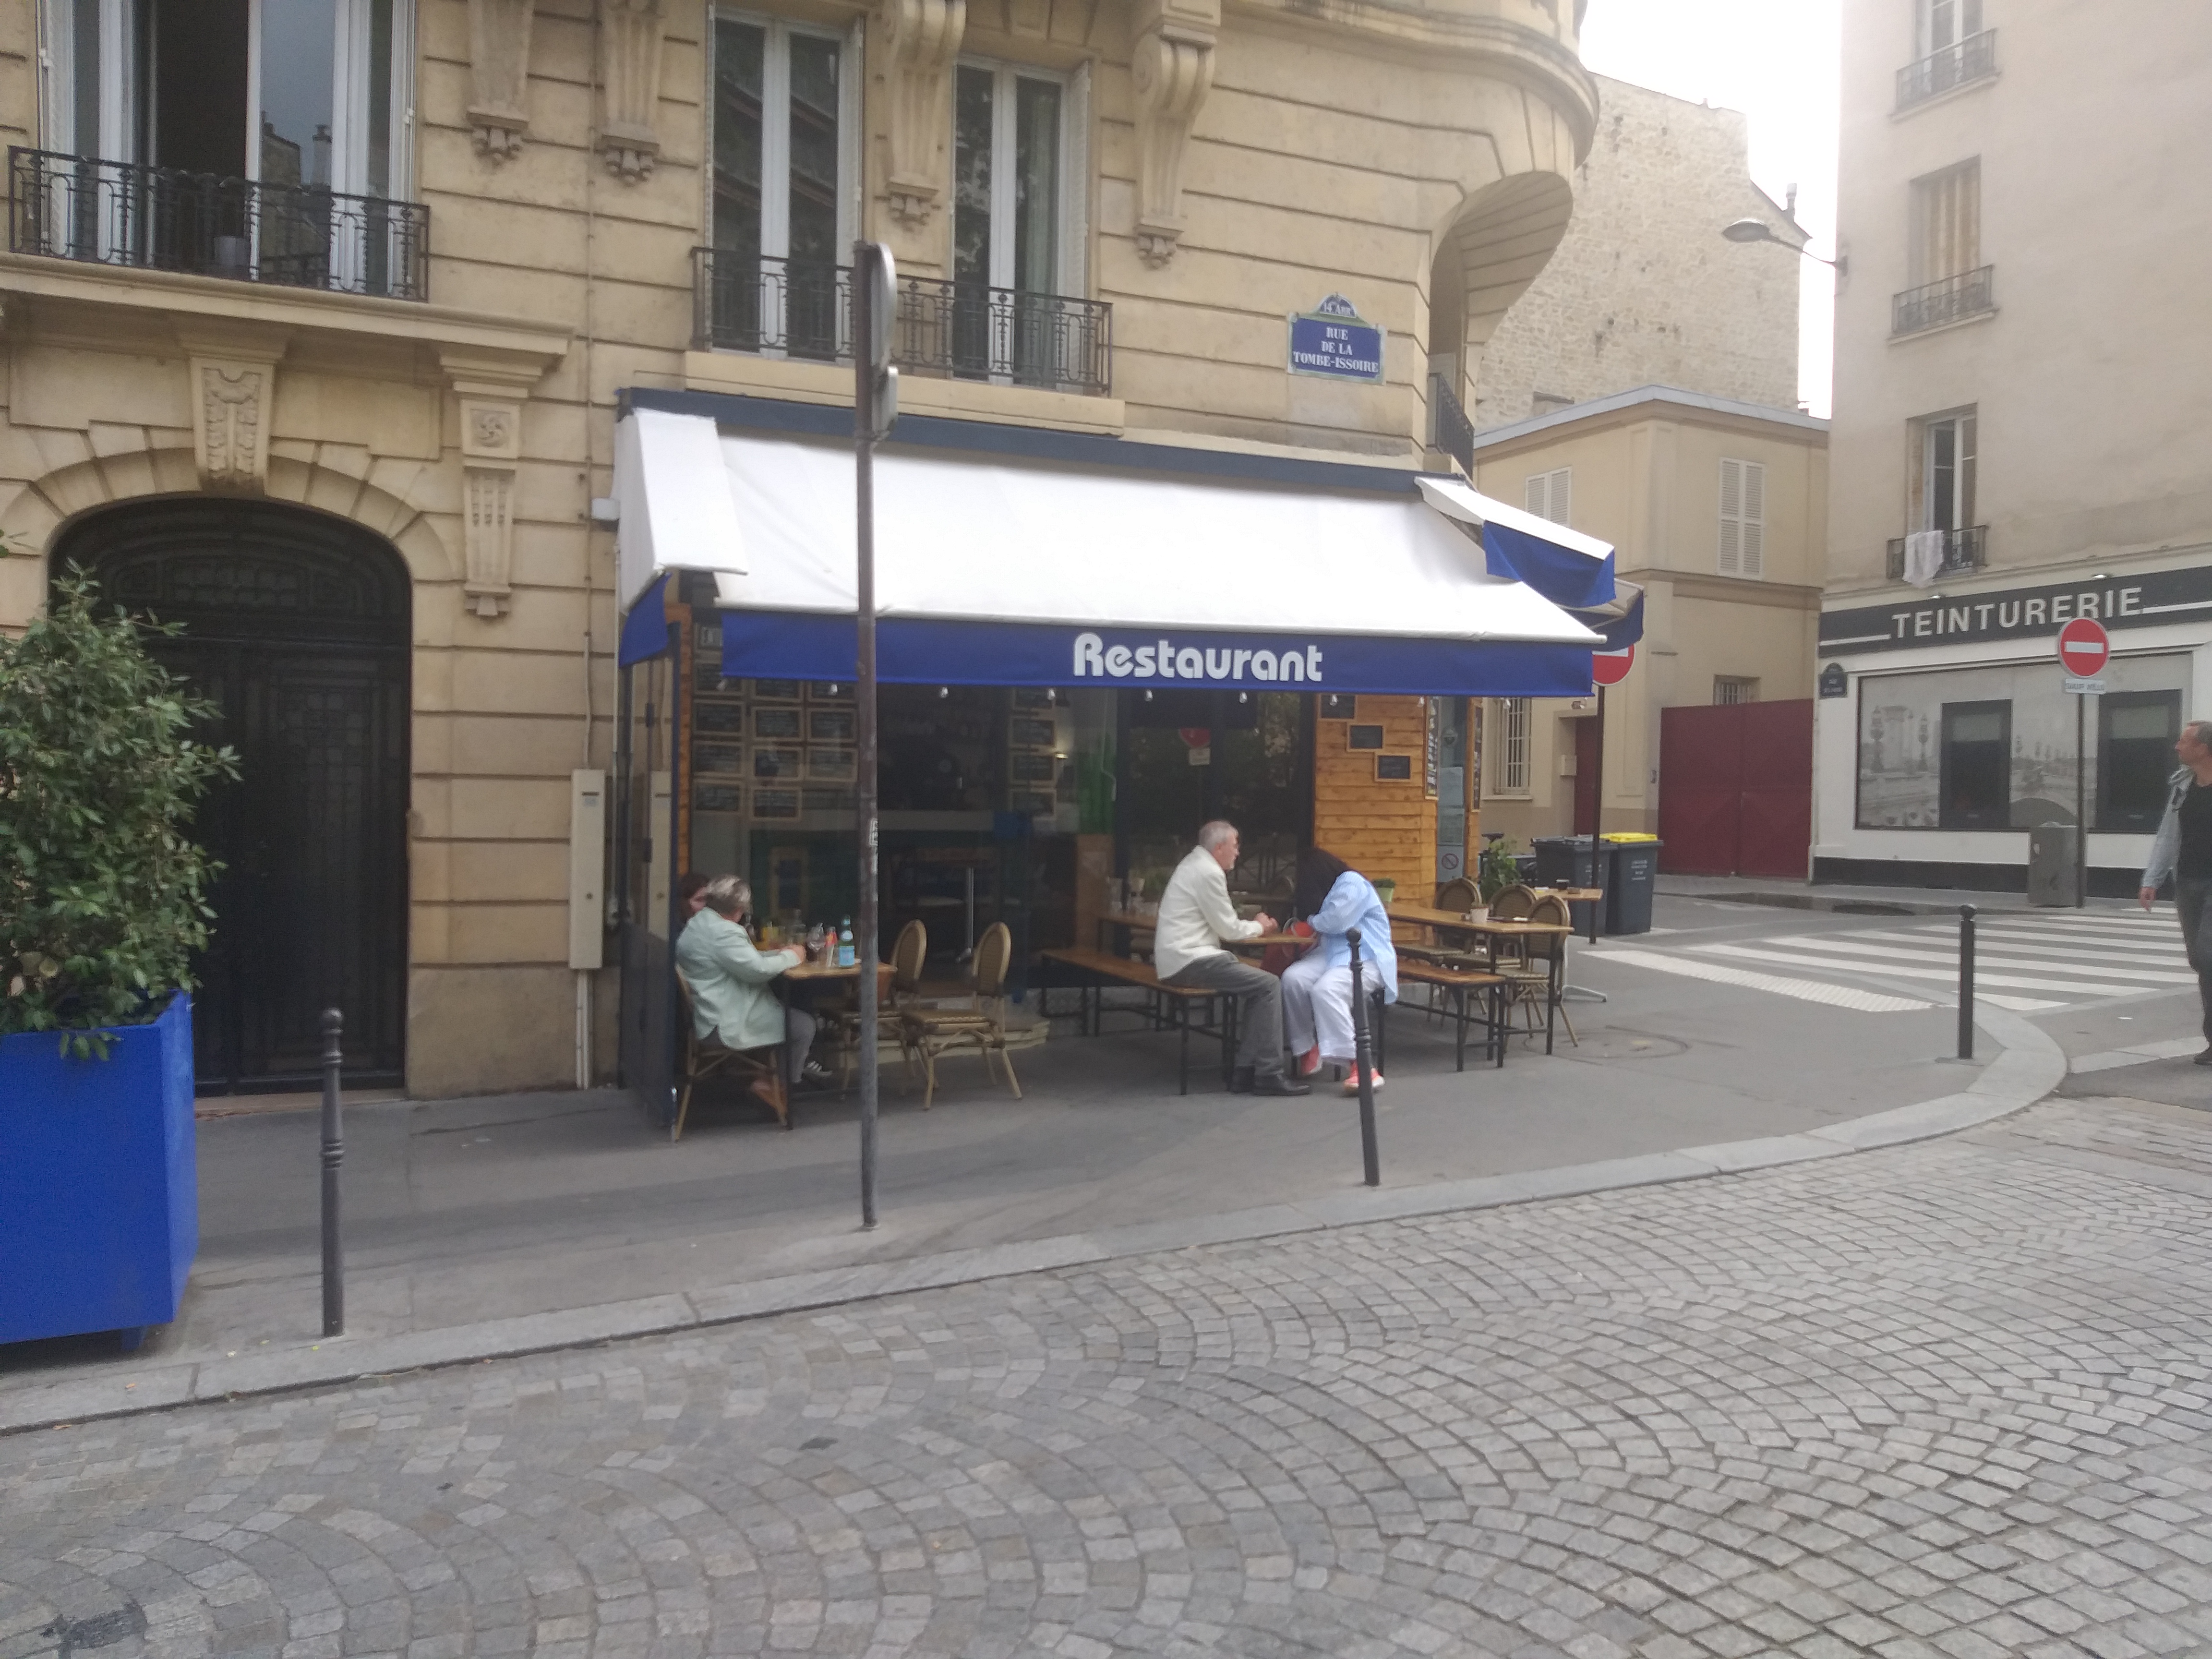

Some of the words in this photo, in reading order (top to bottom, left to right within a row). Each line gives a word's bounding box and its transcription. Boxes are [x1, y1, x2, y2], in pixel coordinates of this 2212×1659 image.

[1326, 326, 1348, 340] RUE
[1322, 341, 1335, 353] DE
[1339, 343, 1353, 355] LA
[1293, 351, 1378, 373] TOMBE-ISSOIRE
[1892, 587, 2142, 638] TEINTURERIE
[1074, 632, 1322, 682] Restaurant
